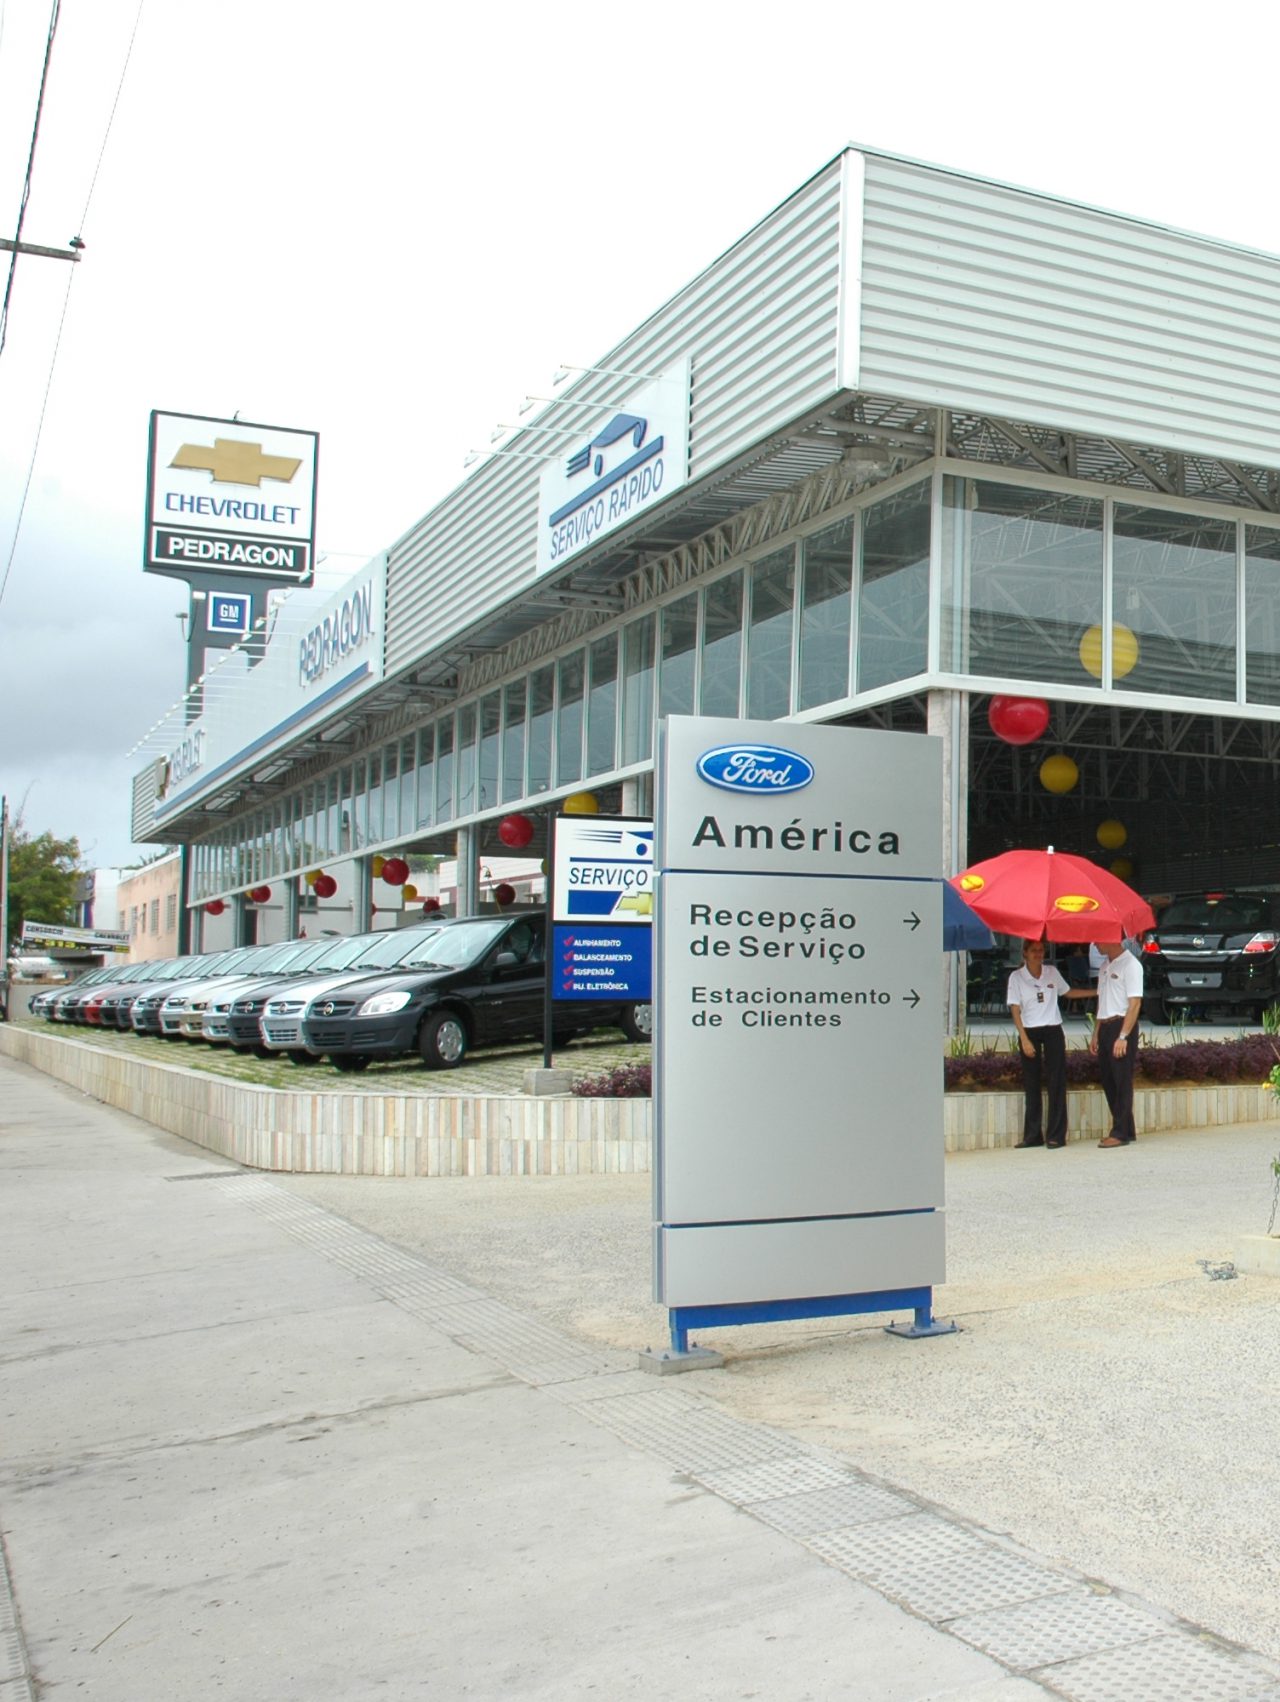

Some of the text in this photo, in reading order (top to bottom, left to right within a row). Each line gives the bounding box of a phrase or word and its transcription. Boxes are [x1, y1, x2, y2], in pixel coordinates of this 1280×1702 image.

[165, 492, 301, 525] CHEVROLET
[551, 499, 604, 560] SERVIÇO
[168, 536, 295, 568] PEDRAGON
[219, 603, 240, 620] GM
[300, 579, 373, 682] PEDRAGON
[722, 752, 793, 785] Ford
[691, 815, 901, 856] América
[569, 867, 648, 890] SERVIÇO
[689, 903, 857, 935] Recepção
[689, 935, 867, 966] de Serviço
[573, 967, 615, 976] SUSPENSÃO
[691, 986, 892, 1005] Estacionamento
[691, 1010, 842, 1028] de Clientes
